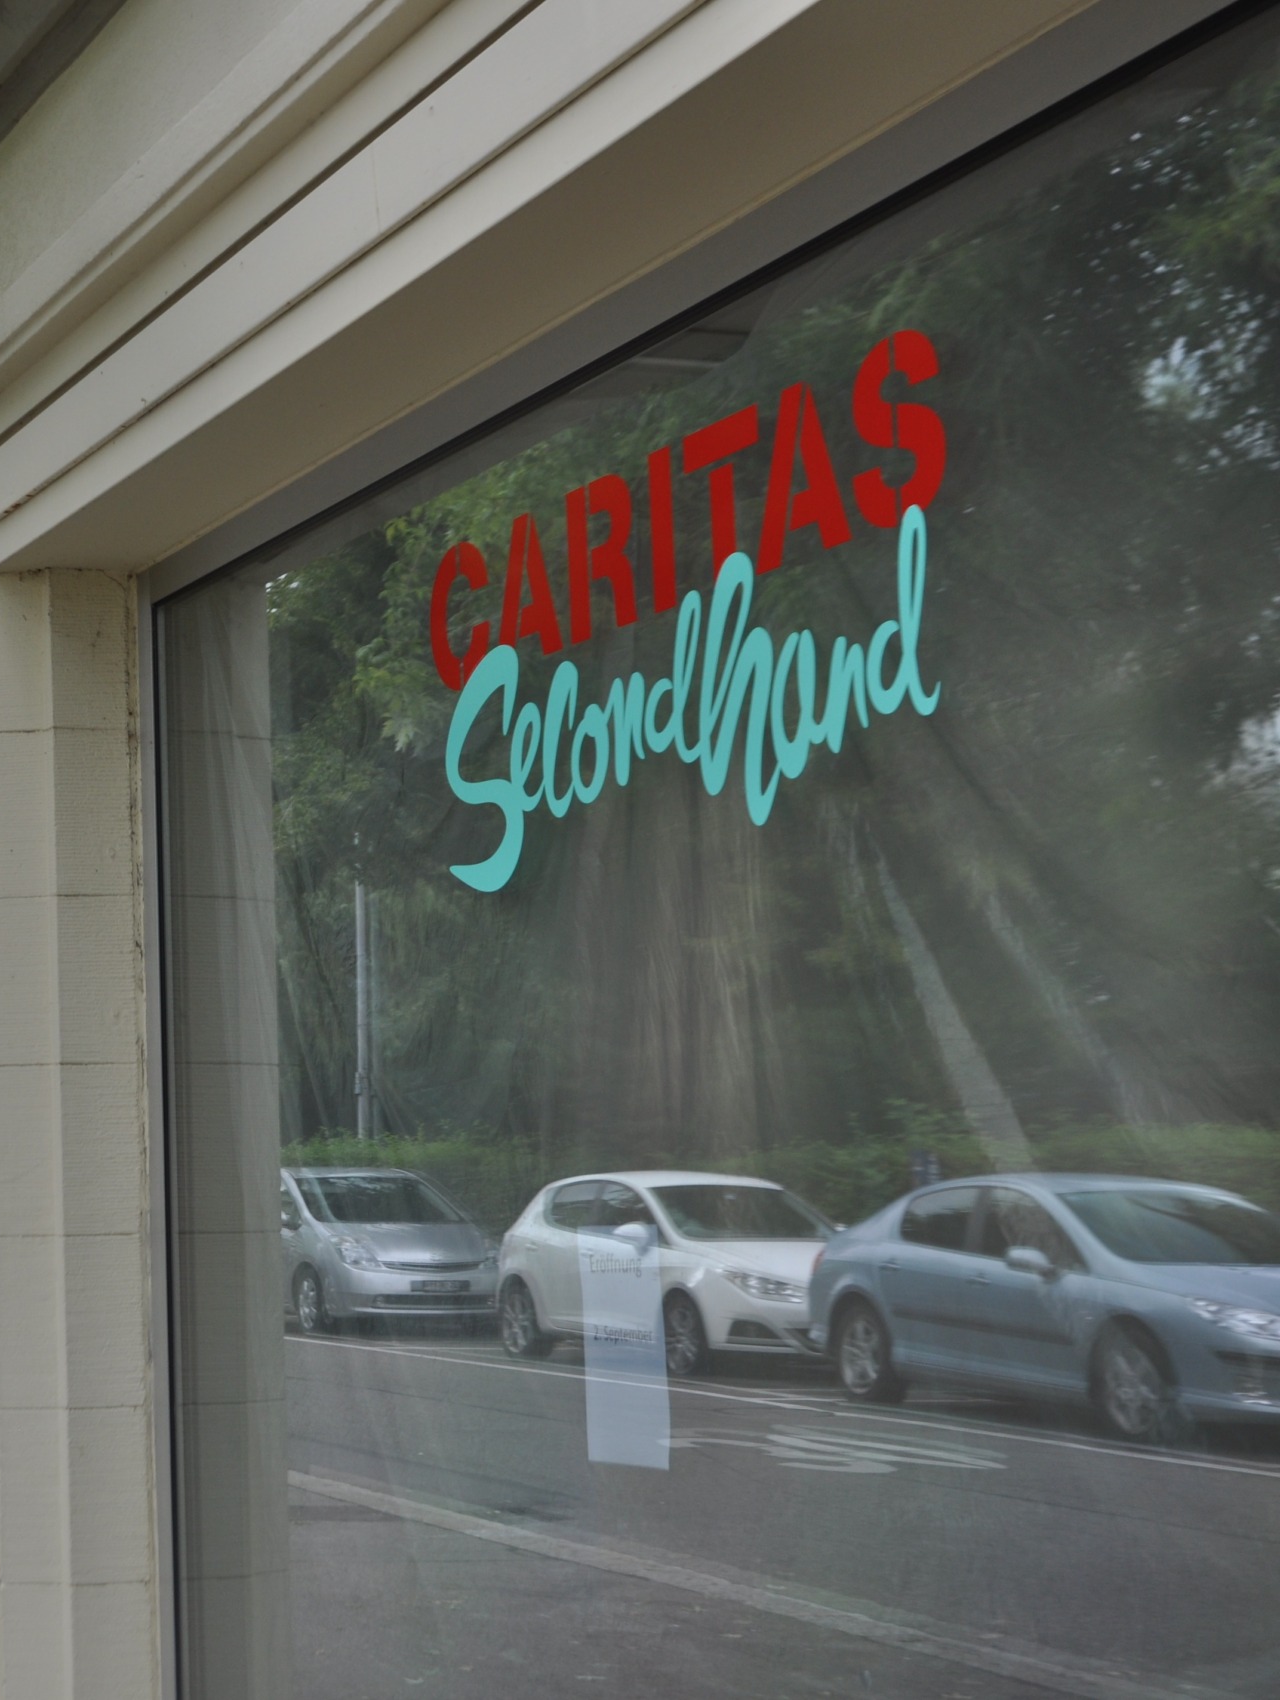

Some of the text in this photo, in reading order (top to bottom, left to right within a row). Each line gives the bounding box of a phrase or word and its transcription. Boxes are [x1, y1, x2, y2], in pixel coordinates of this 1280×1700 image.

[430, 330, 947, 691] CARITAS
[589, 1253, 642, 1278] Eröffnung
[604, 1325, 654, 1345] September
